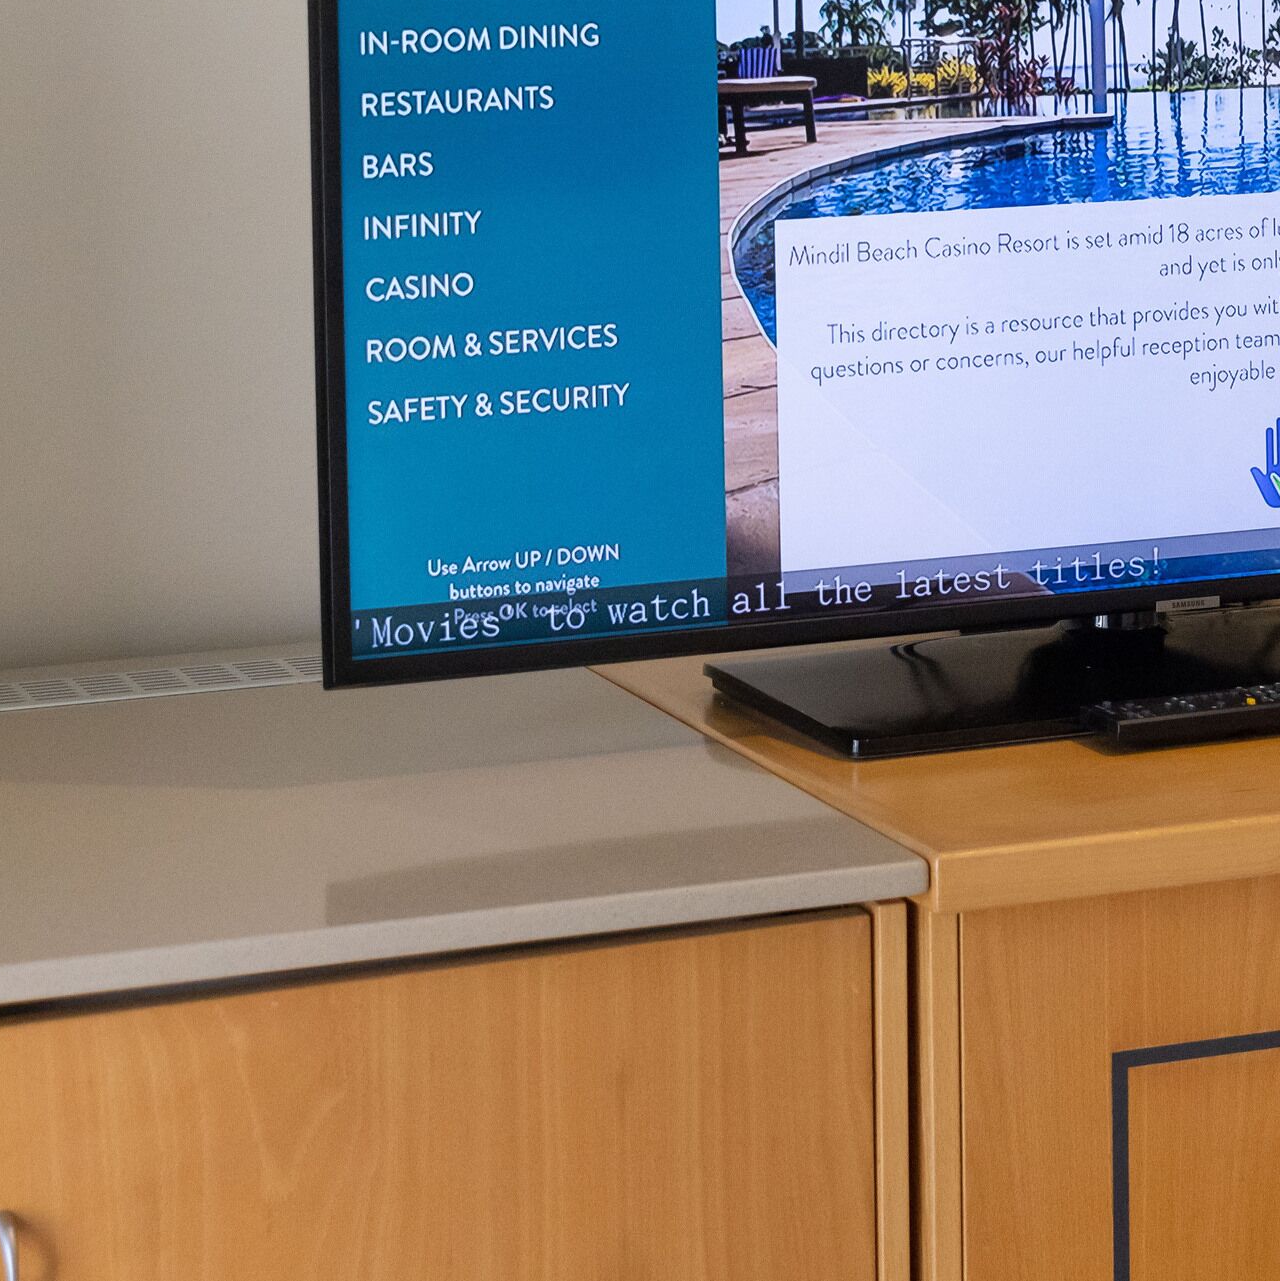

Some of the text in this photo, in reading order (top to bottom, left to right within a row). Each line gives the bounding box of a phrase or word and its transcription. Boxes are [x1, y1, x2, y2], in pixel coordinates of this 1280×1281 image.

[360, 22, 600, 56] IN-ROOM DINING
[361, 85, 554, 117] RESTAURANTS
[362, 151, 434, 179] BARS
[364, 210, 482, 241] INFINITY
[789, 242, 850, 267] Mindil
[857, 239, 918, 262] Beach
[924, 236, 992, 259] Casino
[997, 232, 1060, 254] Resort
[1066, 230, 1080, 250] is
[1085, 232, 1113, 250] set
[1118, 224, 1163, 248] amid
[1168, 222, 1190, 244] 18
[1195, 226, 1244, 243] acres
[1248, 216, 1269, 240] of
[1159, 254, 1193, 277] and
[1197, 257, 1227, 282] yet
[1233, 252, 1246, 272] is
[365, 272, 474, 302] CASINO
[827, 323, 866, 345] This
[871, 321, 960, 345] directory
[966, 315, 979, 335] is
[984, 321, 995, 334] a
[1001, 314, 1084, 333] resource
[1089, 306, 1127, 327] that
[1133, 300, 1210, 332] provides
[1214, 304, 1247, 327] you
[366, 323, 618, 363] ROOM & SERVICES
[810, 355, 904, 387] questions
[909, 358, 930, 373] or
[935, 352, 1029, 371] concerns,
[1035, 348, 1067, 364] our
[1072, 336, 1136, 367] helpful
[1142, 332, 1229, 361] reception
[1235, 333, 1280, 350] team
[1189, 359, 1276, 392] enjoyable
[367, 382, 630, 425] SAFETY & SECURITY
[427, 543, 620, 577] Use Arrow UP / DOWN
[449, 573, 600, 601] buttons to navigate
[547, 604, 586, 631] to
[608, 589, 712, 625] watch
[732, 582, 792, 615] all
[814, 575, 873, 606] the
[895, 563, 1012, 599] latest
[1031, 546, 1162, 586] titles!
[499, 601, 528, 620] OK
[1171, 599, 1205, 609] SAMSUNG
